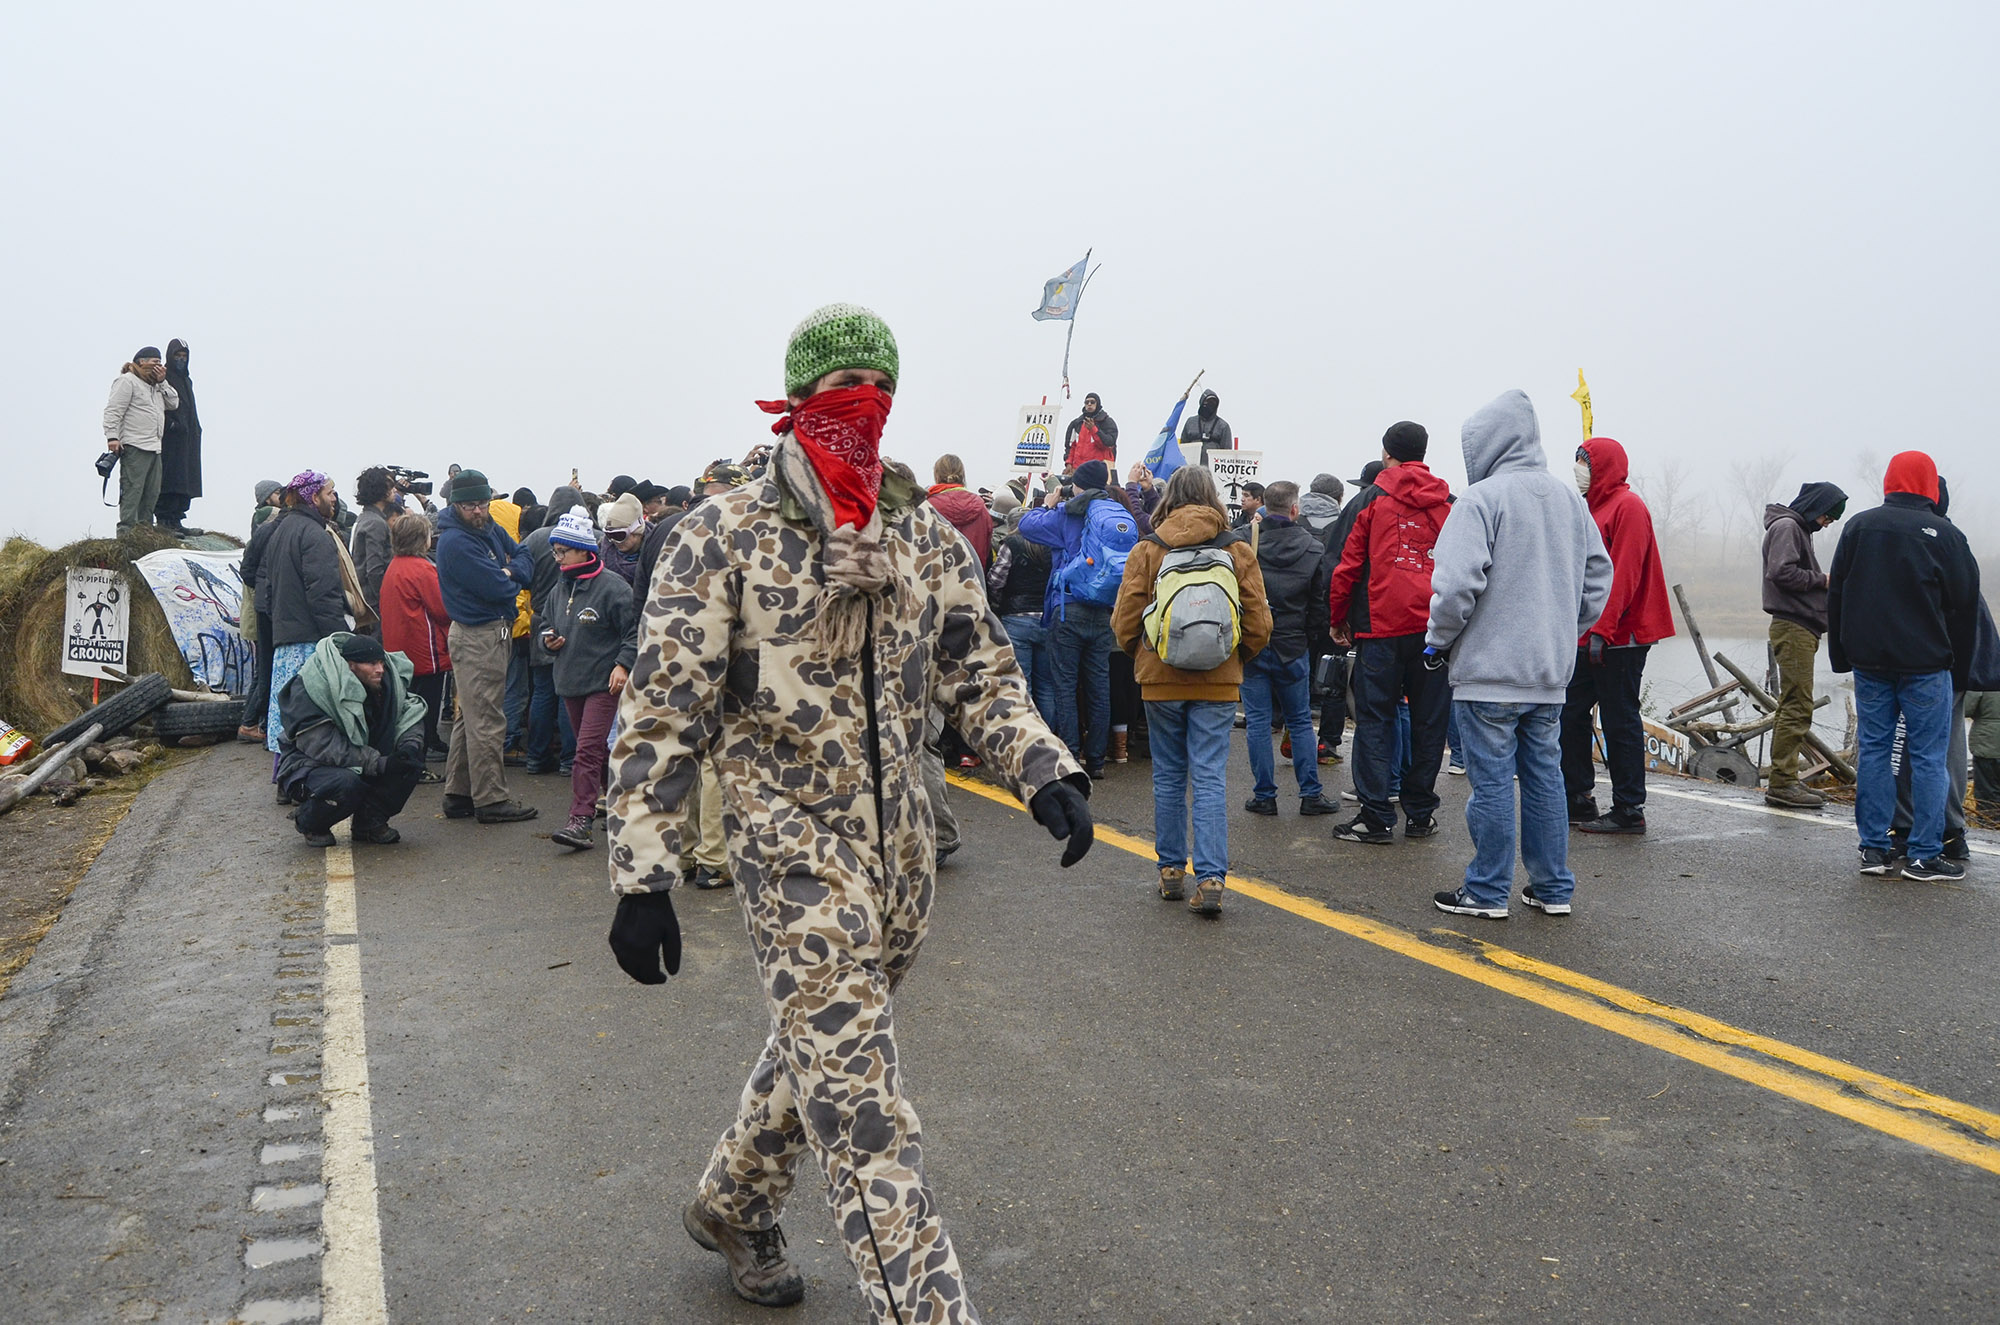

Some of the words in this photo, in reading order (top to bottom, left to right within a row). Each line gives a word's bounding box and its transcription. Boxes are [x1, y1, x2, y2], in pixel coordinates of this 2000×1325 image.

[1026, 414, 1053, 424] WATER
[1027, 433, 1044, 443] LIFE
[1214, 463, 1258, 475] PROTECT
[70, 637, 89, 646] KEEP
[107, 641, 122, 649] THE
[70, 646, 122, 662] GROUND
